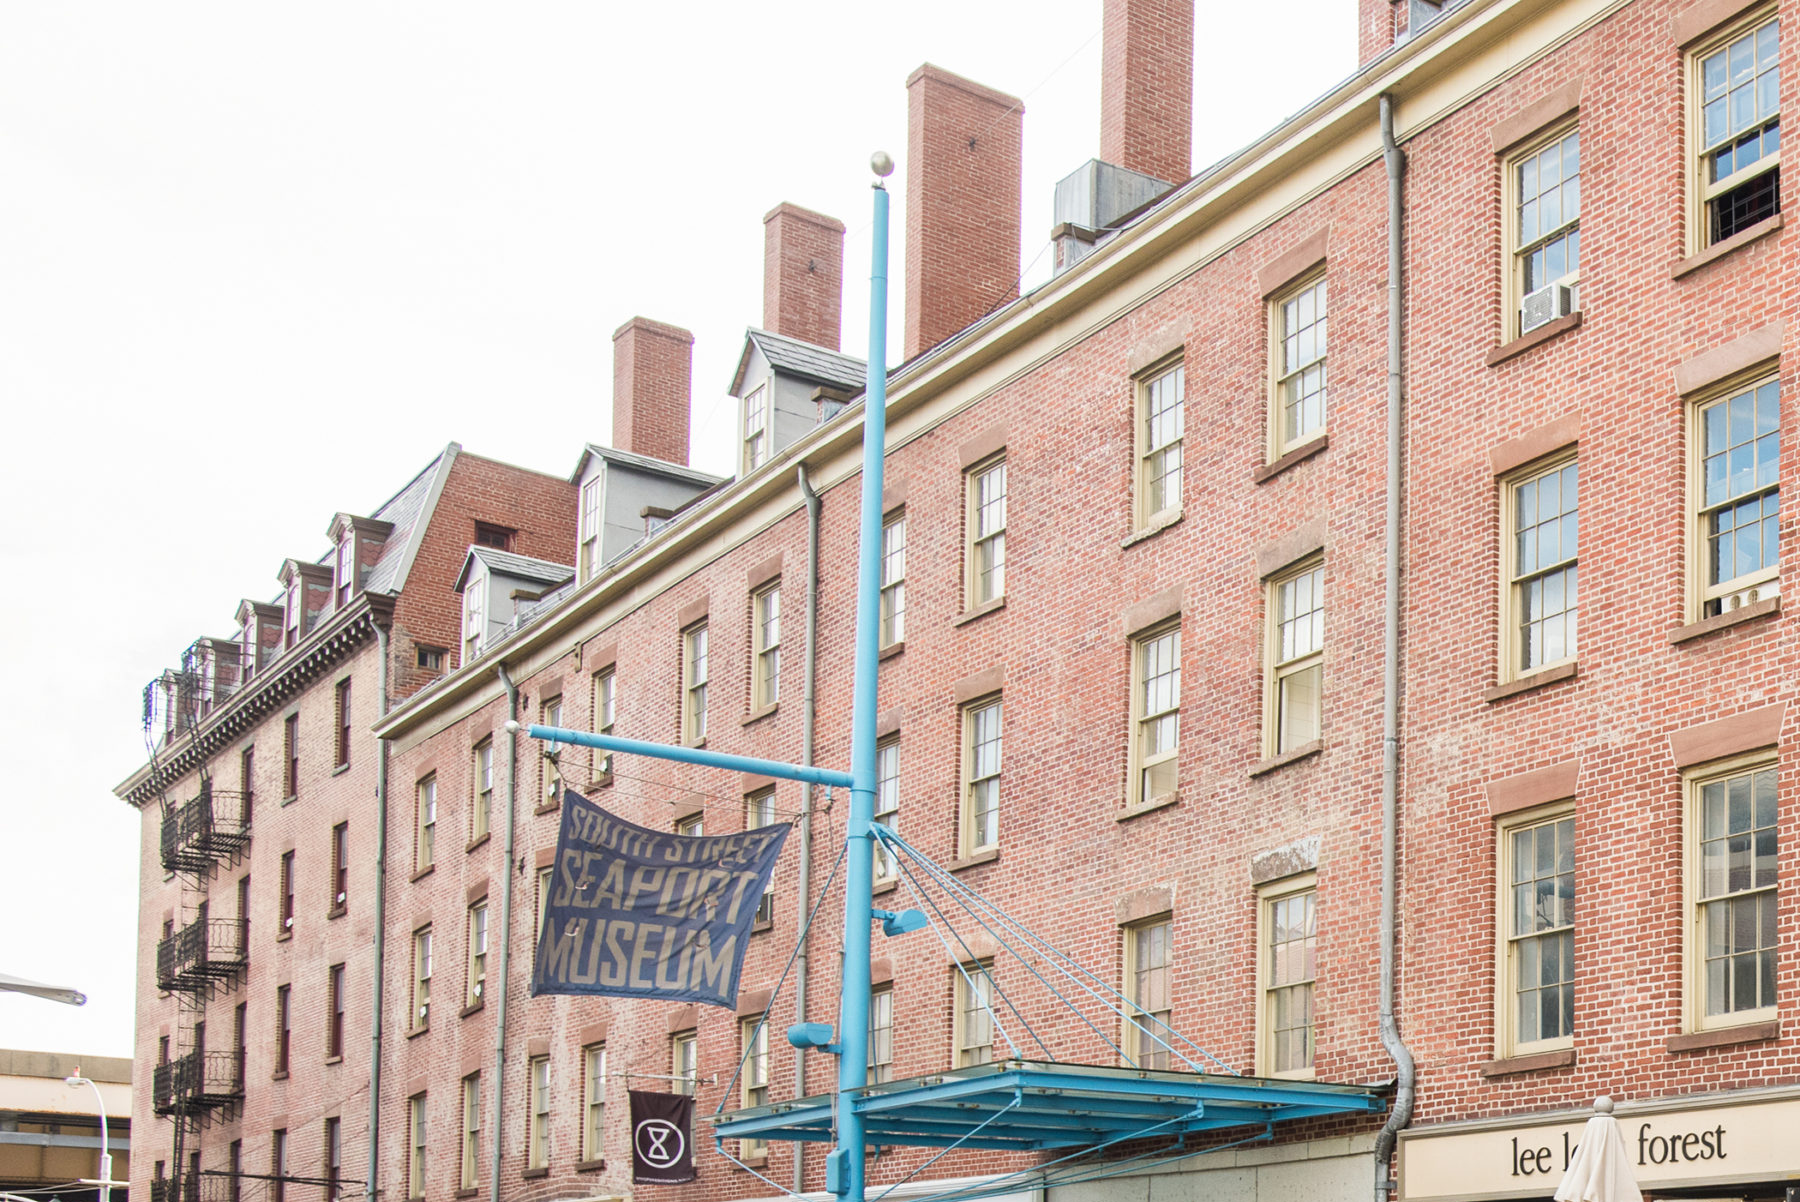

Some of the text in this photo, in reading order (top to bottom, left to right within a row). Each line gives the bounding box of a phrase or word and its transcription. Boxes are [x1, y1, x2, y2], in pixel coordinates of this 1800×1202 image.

[569, 805, 777, 863] SOUTH STREET
[553, 848, 759, 924] SEAPORT
[538, 917, 738, 998] MUSEUM
[1511, 1137, 1552, 1176] lee
[1637, 1123, 1728, 1166] forest
